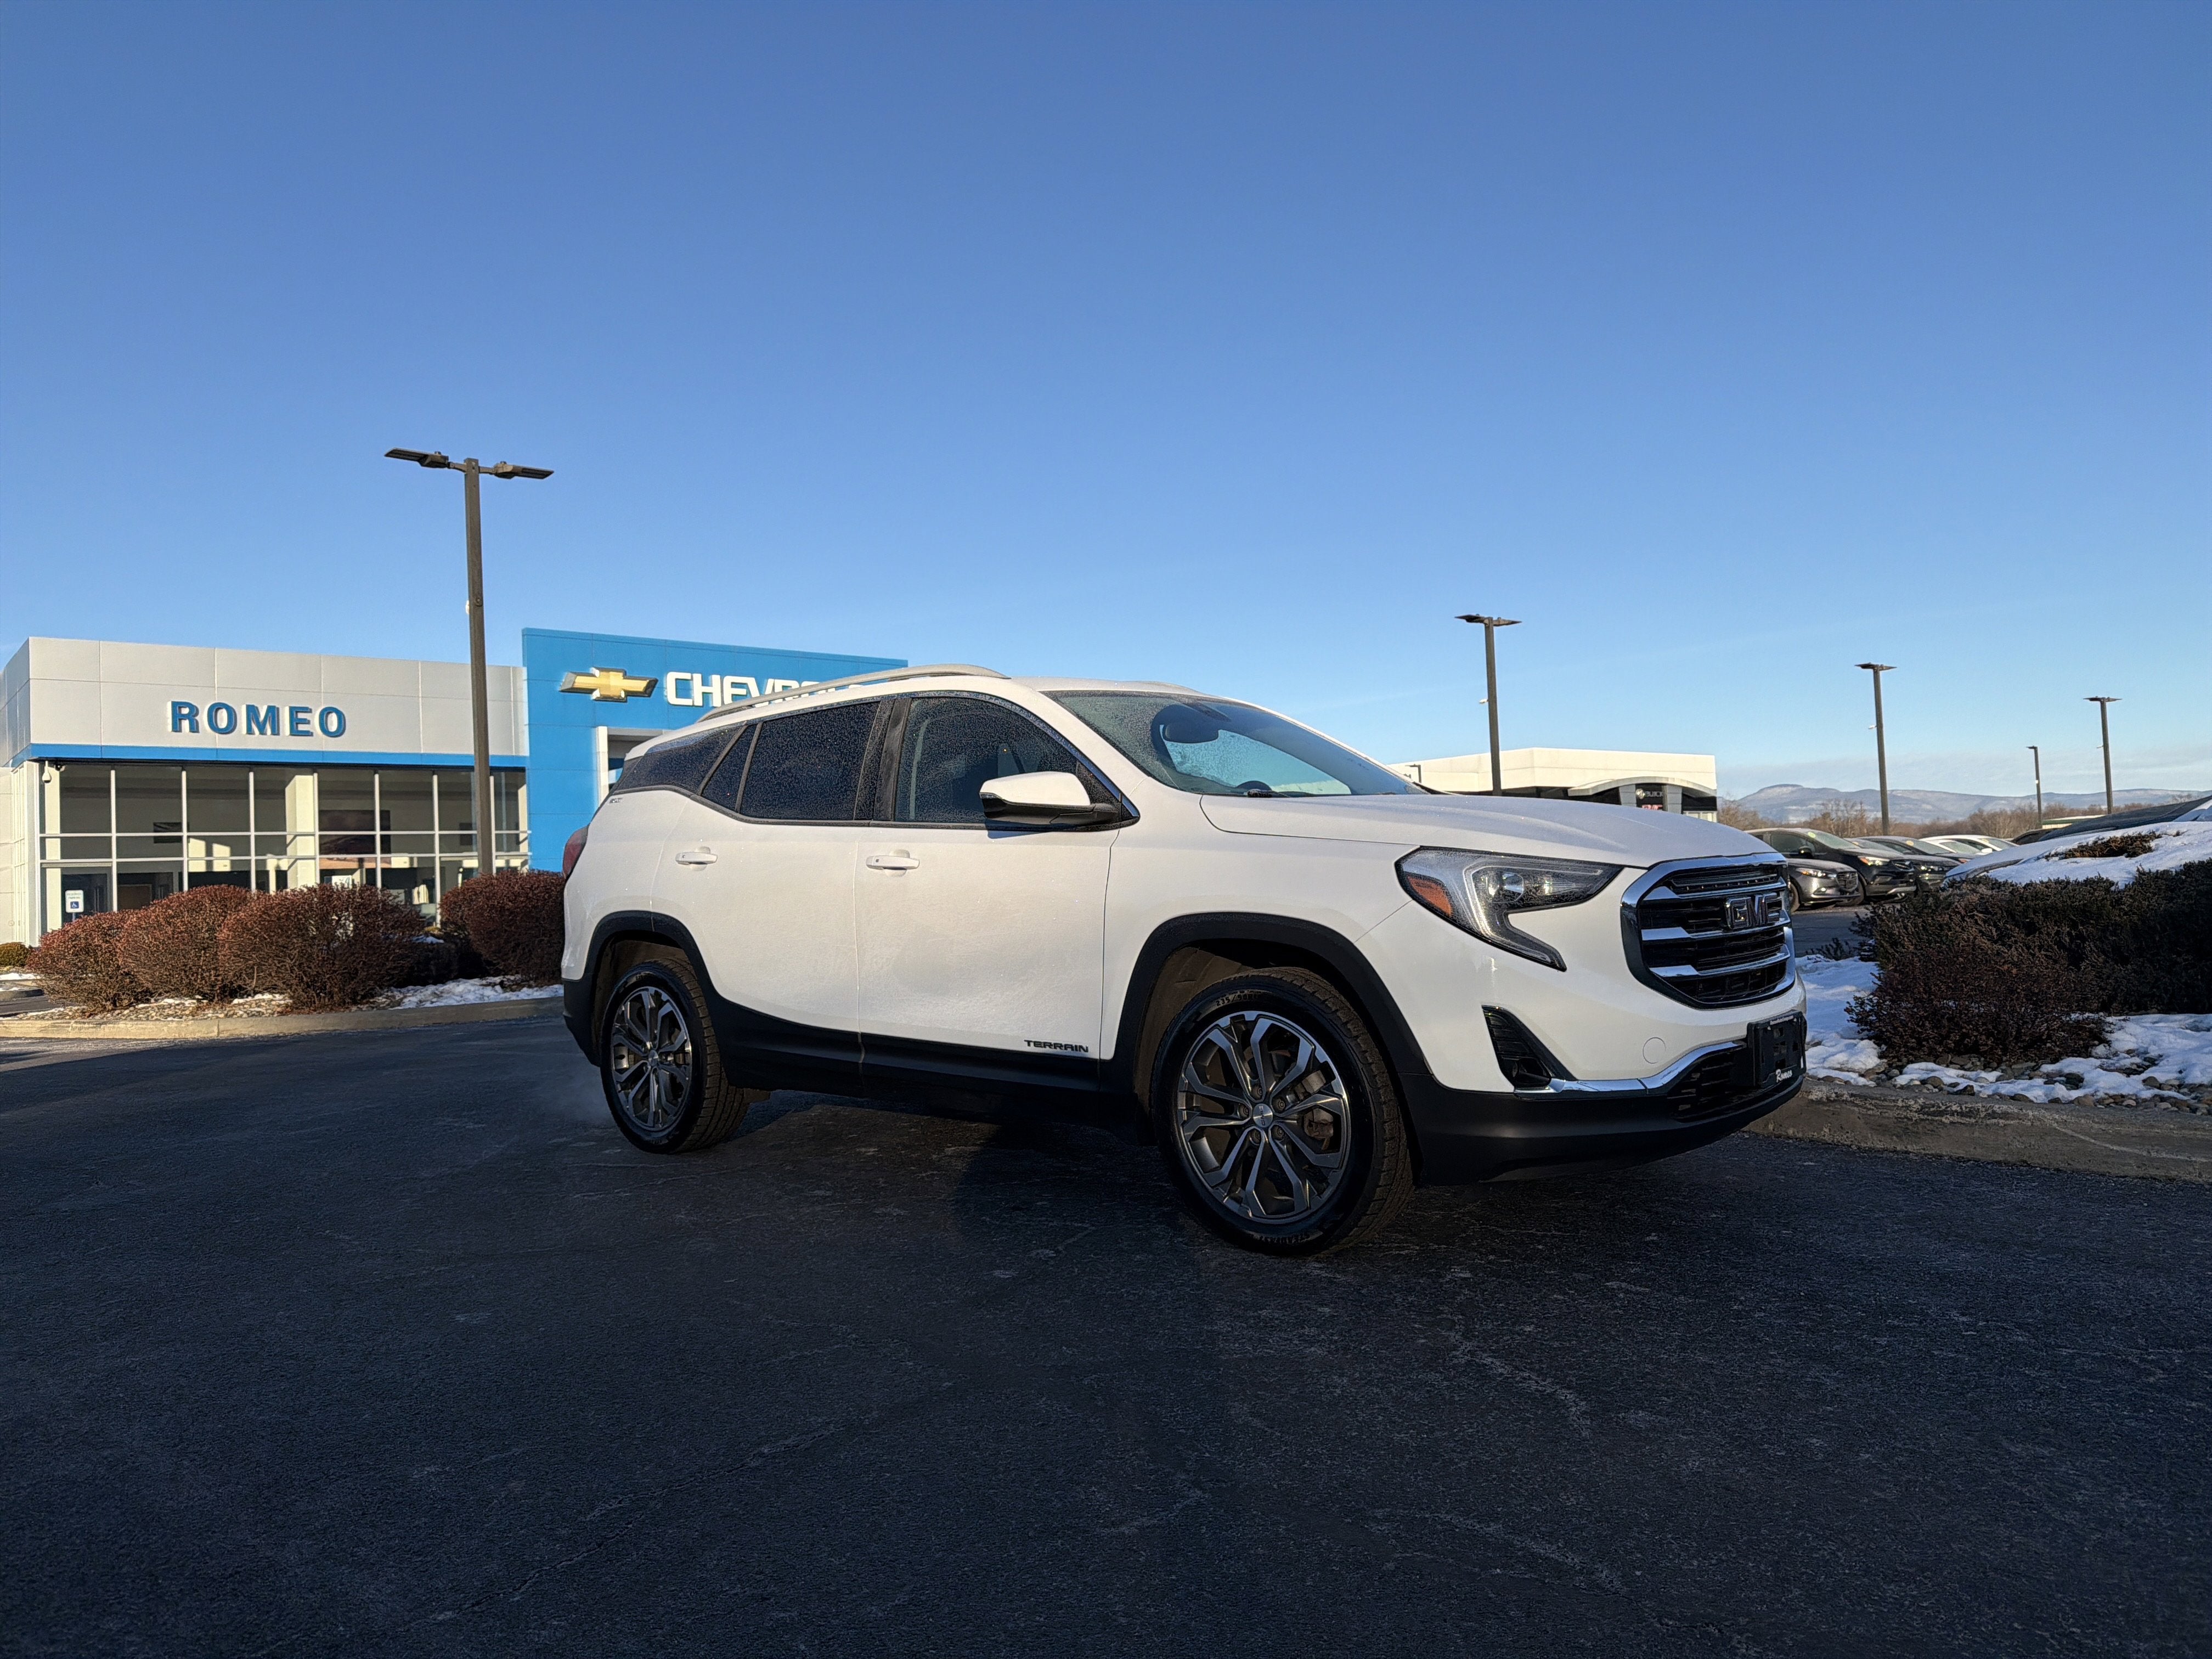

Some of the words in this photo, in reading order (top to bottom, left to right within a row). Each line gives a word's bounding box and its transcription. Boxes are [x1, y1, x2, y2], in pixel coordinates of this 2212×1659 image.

[666, 671, 862, 708] CHEVR
[169, 701, 346, 738] ROMEO
[1726, 892, 1781, 929] GMC
[1024, 1039, 1088, 1053] TERRAIN
[1775, 1068, 1793, 1083] Romeo
